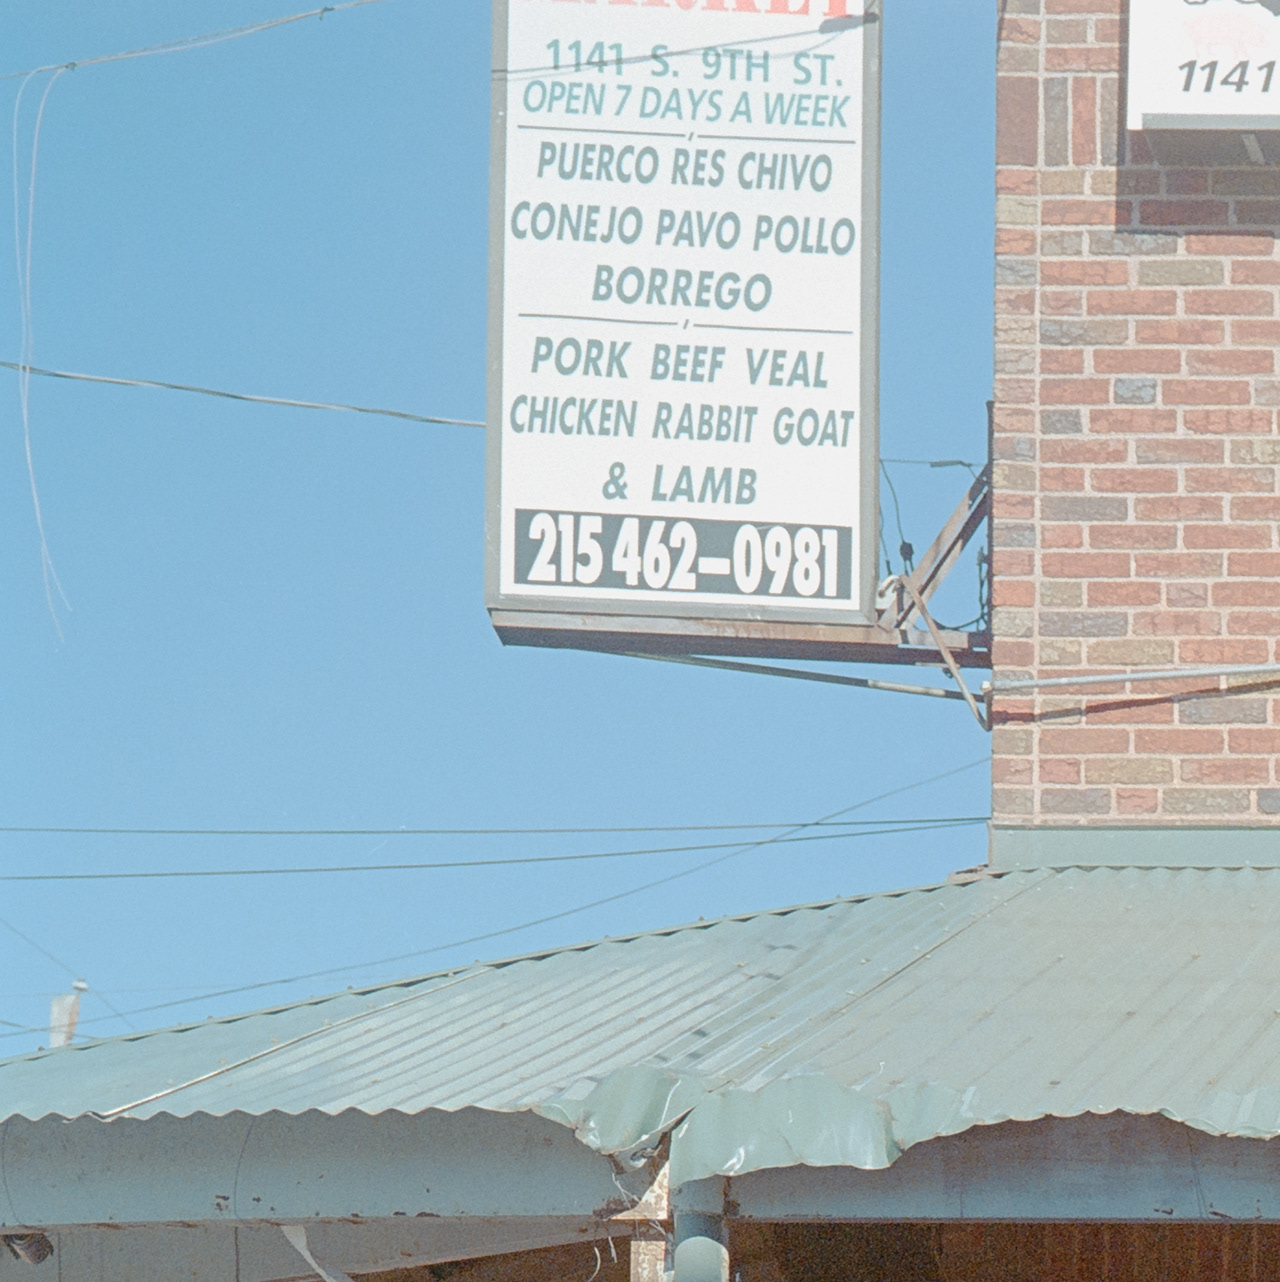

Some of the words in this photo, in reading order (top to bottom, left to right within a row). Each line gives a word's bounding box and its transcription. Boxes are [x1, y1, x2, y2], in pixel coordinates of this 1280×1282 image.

[546, 39, 623, 76] 1141
[651, 44, 679, 77] S.
[702, 49, 769, 82] 9TH
[793, 52, 843, 86] ST.
[1178, 60, 1276, 93] 1141
[523, 80, 606, 116] OPEN
[614, 84, 632, 116] 7
[638, 87, 723, 121] DAYS
[729, 91, 752, 123] A
[764, 92, 850, 127] WEEK
[537, 141, 659, 184] PUERCO
[670, 149, 725, 188] RES
[738, 151, 832, 193] CHIVO
[510, 201, 643, 244] CONEJO
[655, 209, 740, 250] PAVO
[753, 215, 855, 256] POLLO
[592, 265, 772, 312] BORREGO
[531, 336, 631, 379] PORK
[651, 343, 726, 383] BEEF
[746, 348, 828, 388] VEAL
[510, 394, 637, 438] CHICKEN
[652, 401, 757, 443] RABBIT
[773, 407, 854, 448] GOAT
[602, 461, 628, 501] &
[651, 464, 757, 505] LAMB
[528, 513, 603, 583] 215
[612, 521, 838, 597] 462-0981
